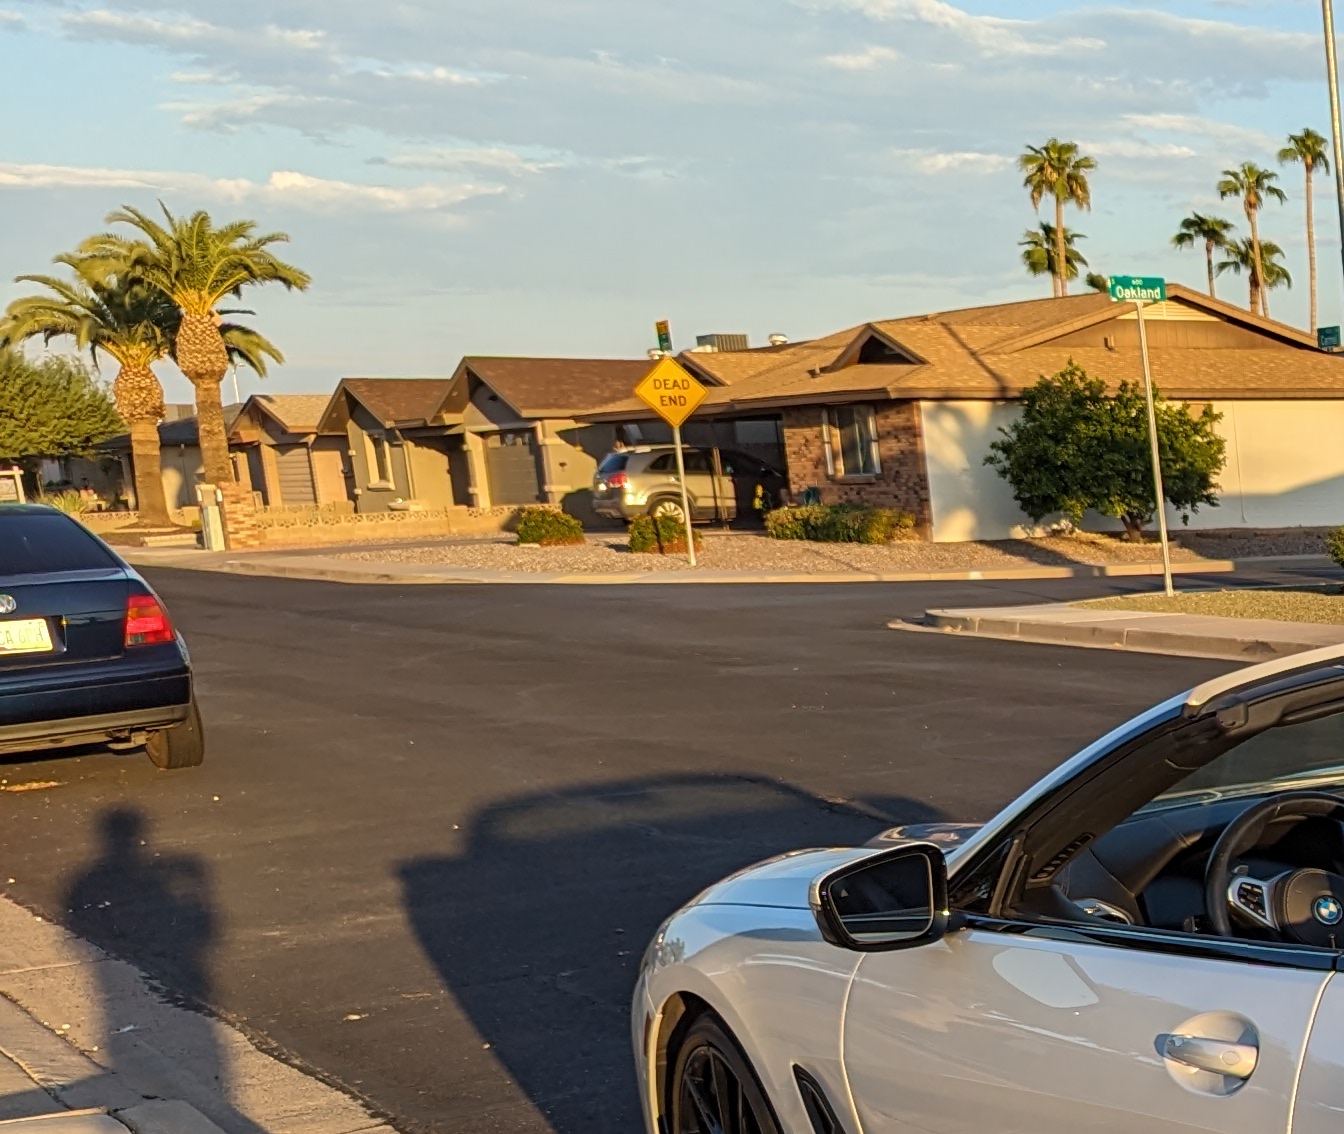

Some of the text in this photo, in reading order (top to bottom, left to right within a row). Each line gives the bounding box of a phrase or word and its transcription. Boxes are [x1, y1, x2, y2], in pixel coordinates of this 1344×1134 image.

[1116, 285, 1161, 300] Oakland
[653, 379, 690, 391] DEAD
[660, 395, 687, 407] END
